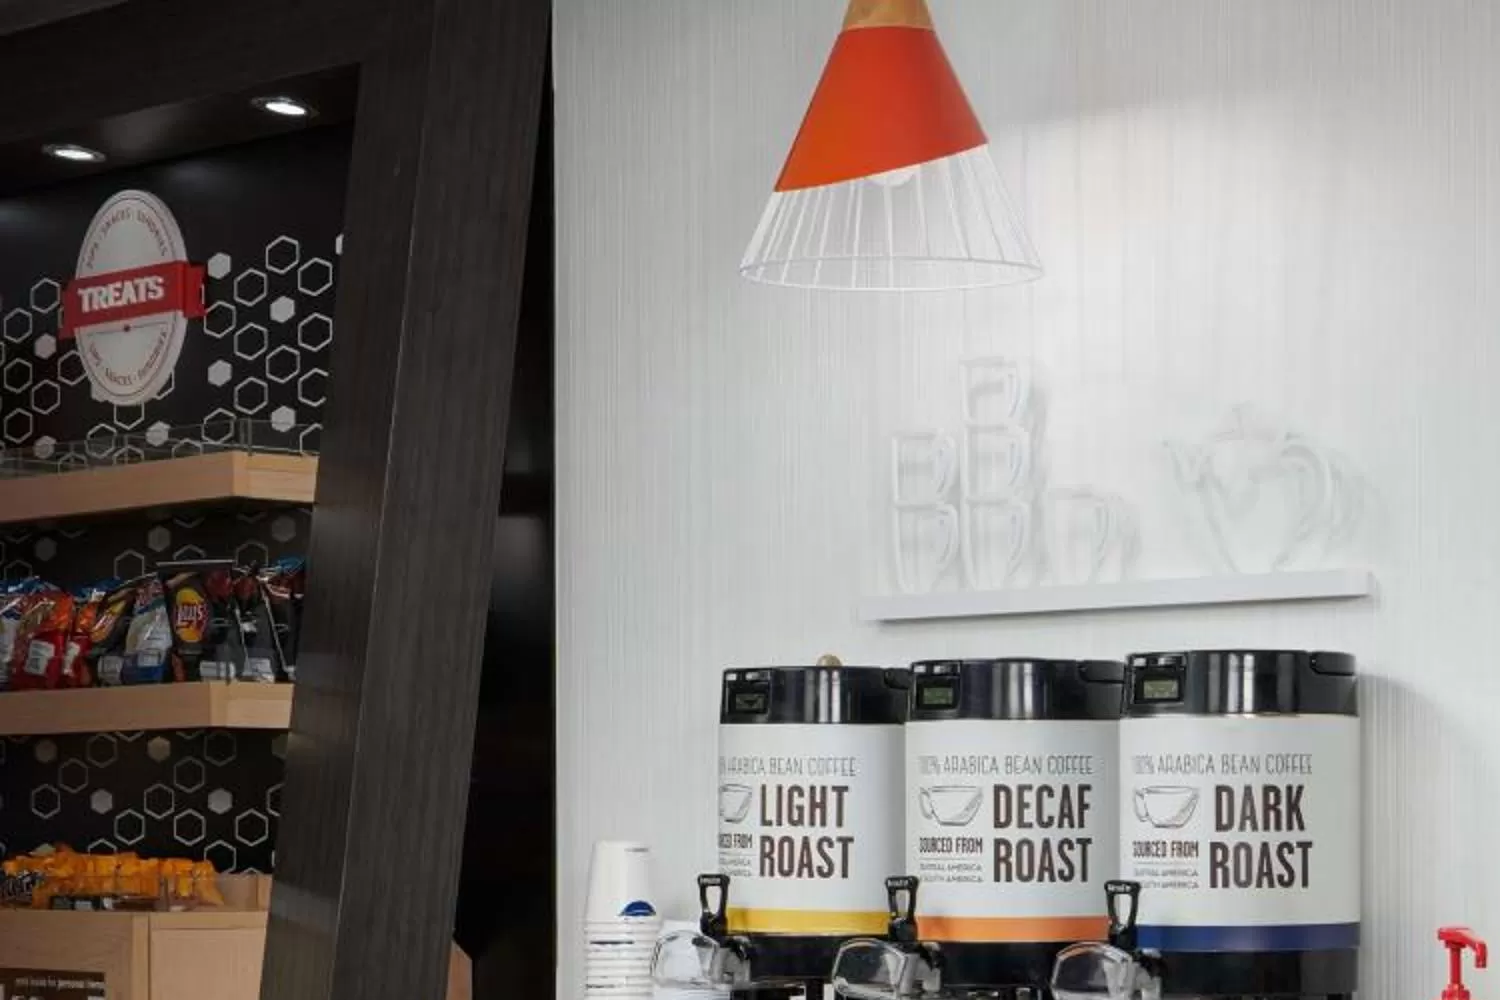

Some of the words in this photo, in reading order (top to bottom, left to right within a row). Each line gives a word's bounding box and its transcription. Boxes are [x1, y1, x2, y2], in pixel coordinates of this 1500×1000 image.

[77, 275, 165, 313] TREATS
[769, 756, 803, 775] BEAN
[1004, 755, 1043, 775] BEAN
[1047, 755, 1094, 775] COFFEE
[1157, 754, 1215, 775] ARABICA
[1221, 754, 1261, 775] BEAN
[1264, 754, 1313, 775] COFFEE
[760, 783, 849, 828] LIGHT
[992, 783, 1092, 829] DECAF
[1214, 783, 1306, 832] DARK
[759, 834, 855, 879] ROAST
[955, 837, 983, 854] FROM
[993, 837, 1093, 883] ROAST
[1170, 841, 1199, 858] FROM
[1209, 840, 1313, 889] ROAST
